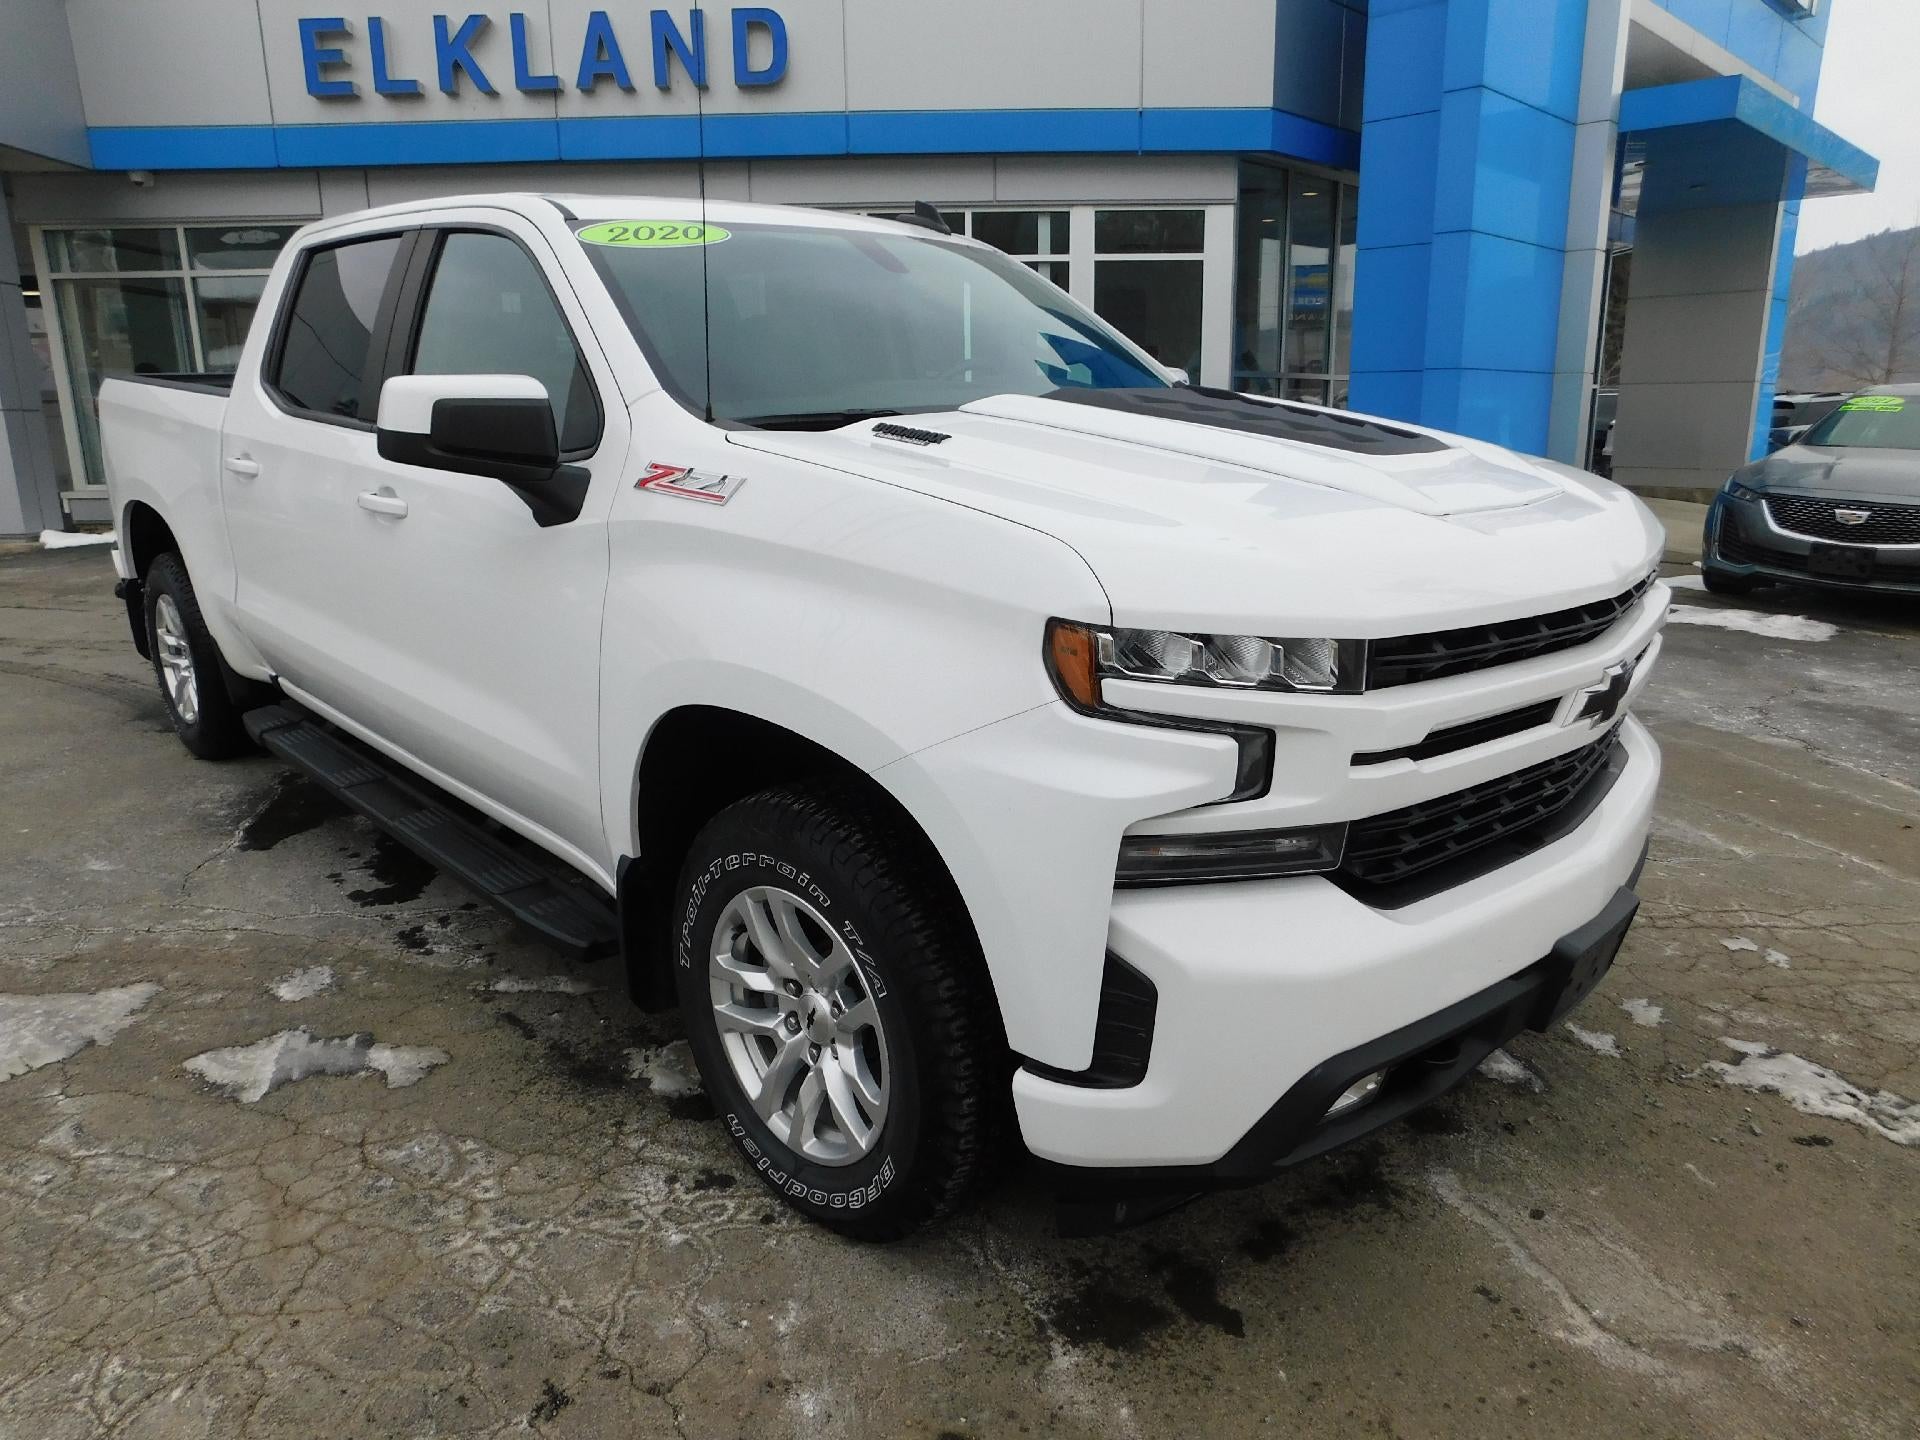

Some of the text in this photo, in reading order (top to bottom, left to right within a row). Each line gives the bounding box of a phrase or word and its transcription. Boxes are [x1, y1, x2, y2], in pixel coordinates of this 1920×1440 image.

[298, 8, 790, 98] ELKLAND
[607, 225, 705, 242] 2020
[633, 460, 747, 506] Z71
[841, 920, 889, 999] T/A
[726, 1113, 896, 1210] BFGoodrich
